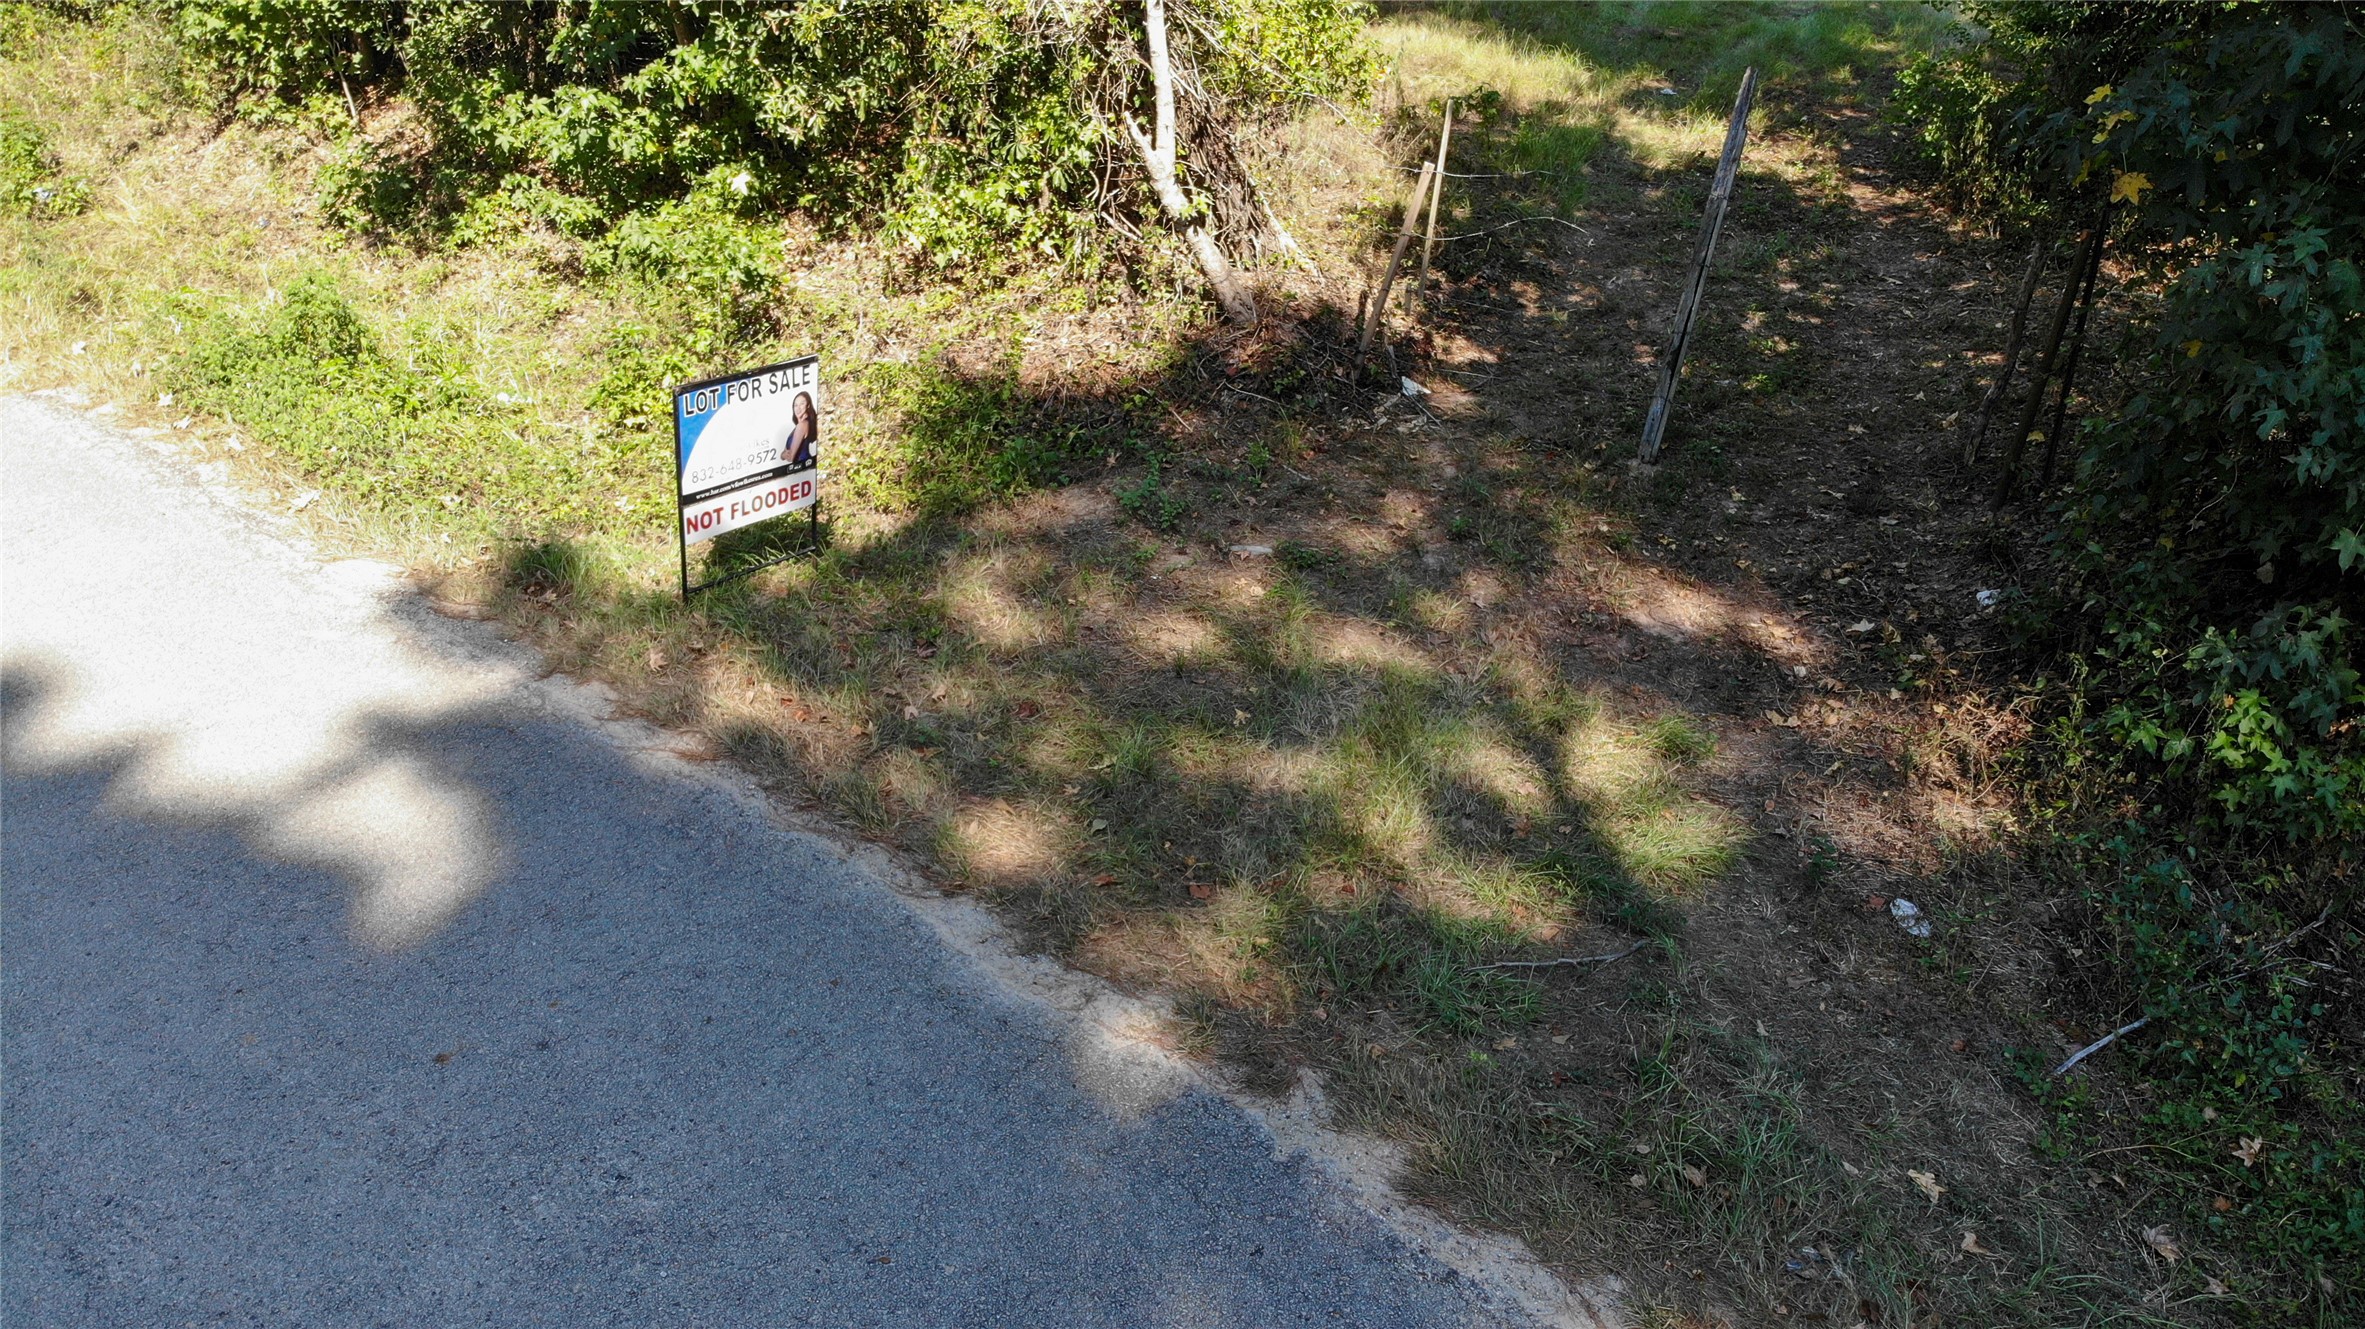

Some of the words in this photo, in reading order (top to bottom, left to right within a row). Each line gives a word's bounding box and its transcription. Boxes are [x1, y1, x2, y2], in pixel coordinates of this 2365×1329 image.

[684, 387, 720, 416] LOT
[727, 378, 762, 405] FOR
[769, 364, 811, 394] SALE
[691, 448, 777, 484] 832-648-9572
[686, 507, 724, 534] NOT
[730, 480, 812, 520] FLOODED
